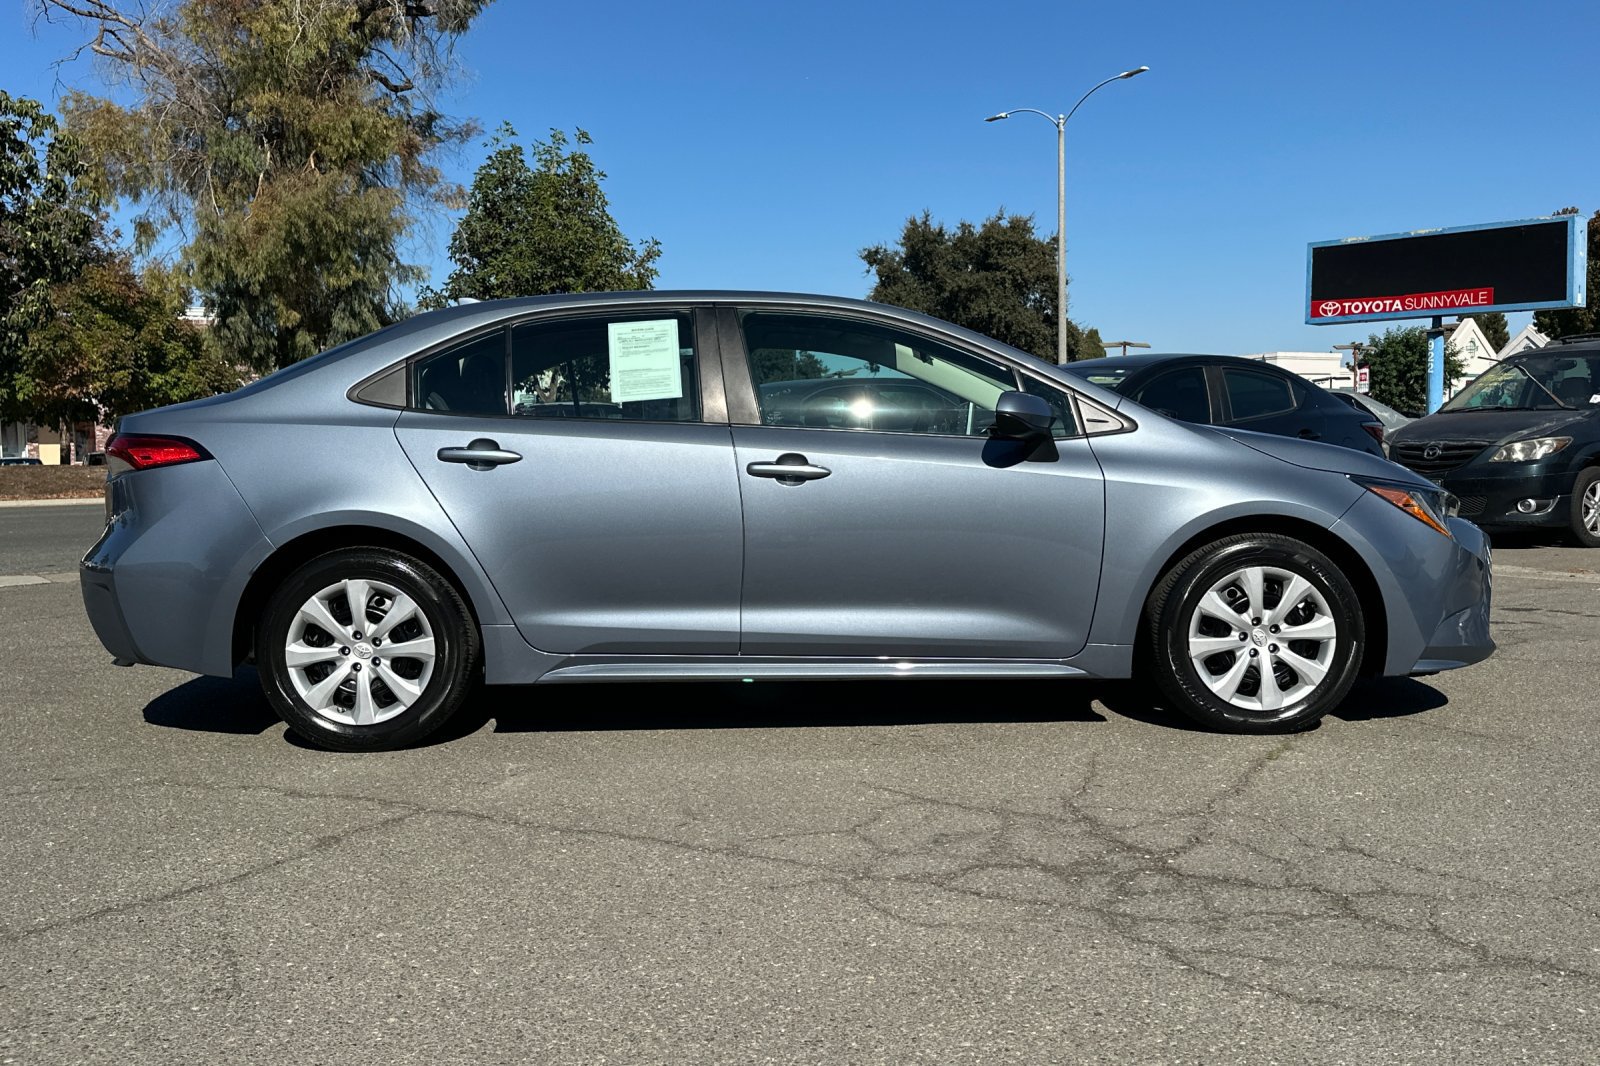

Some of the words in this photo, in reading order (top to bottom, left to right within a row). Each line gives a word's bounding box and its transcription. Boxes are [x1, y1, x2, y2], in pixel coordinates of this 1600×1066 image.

[1343, 300, 1402, 314] TOYOTA
[1404, 291, 1488, 310] SUNNYVALE
[1427, 340, 1435, 374] 922
